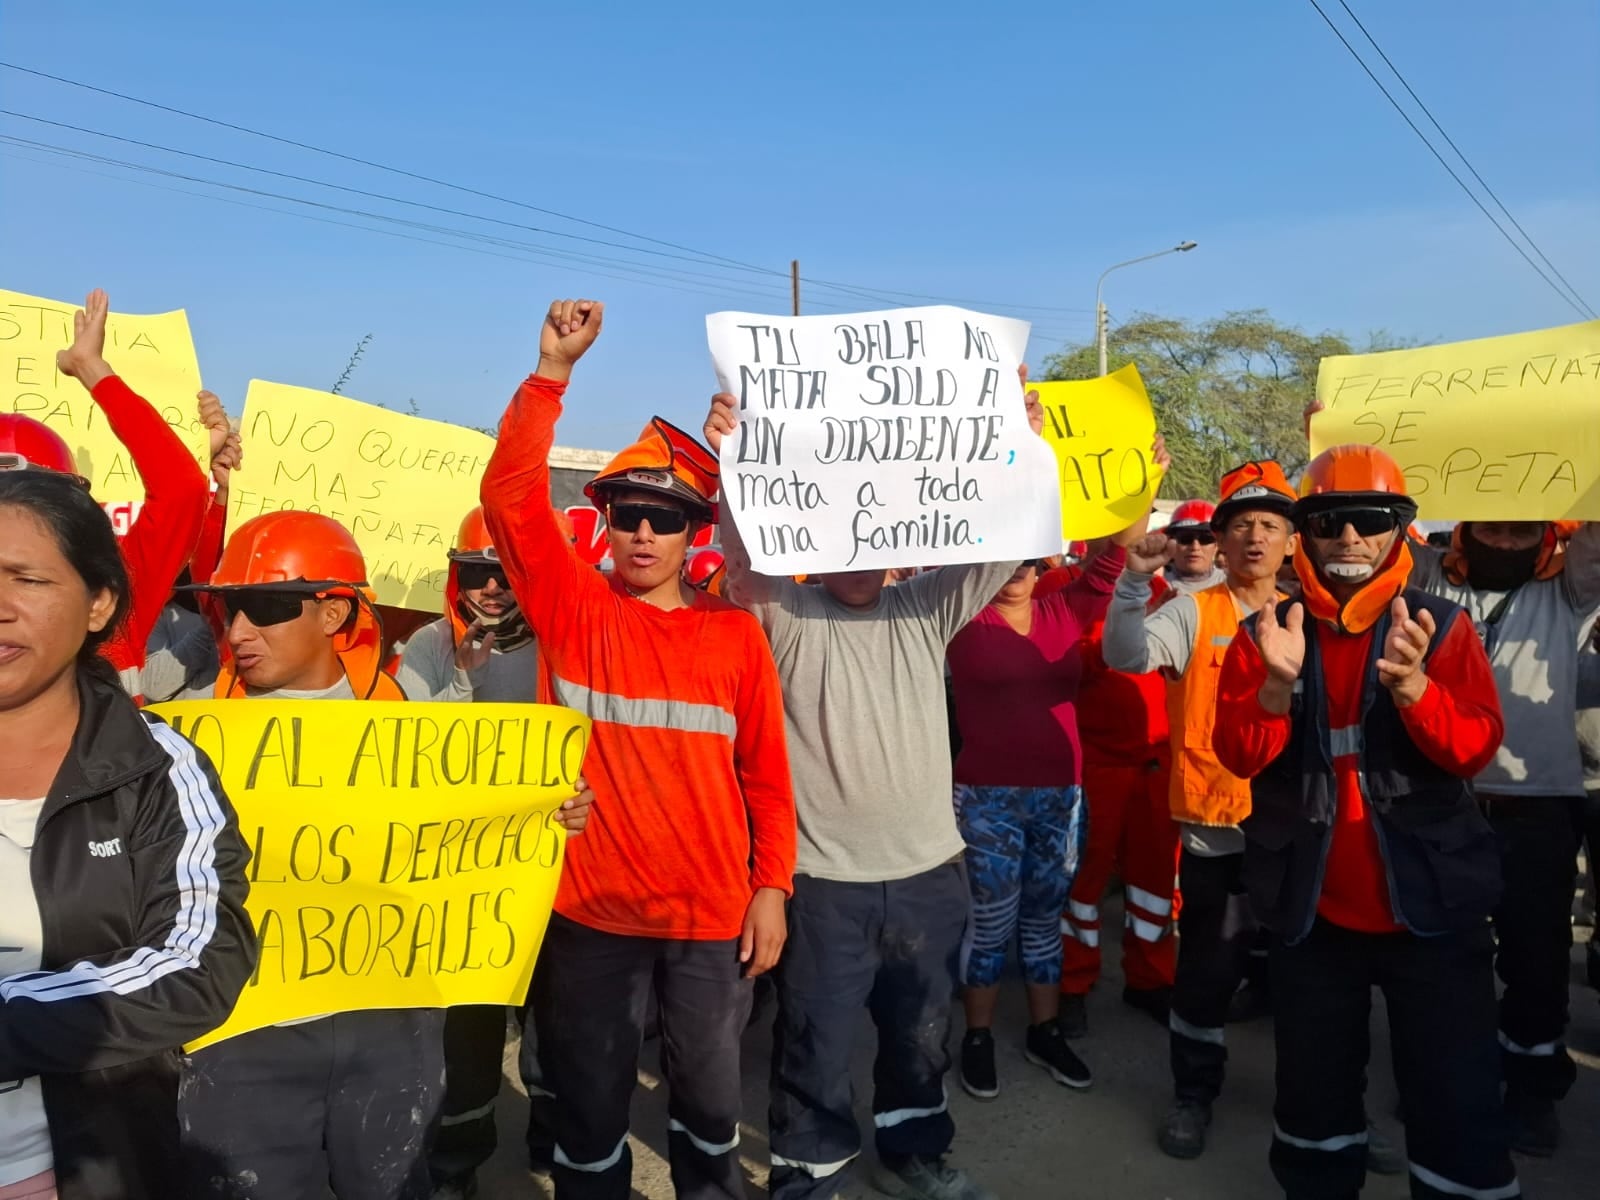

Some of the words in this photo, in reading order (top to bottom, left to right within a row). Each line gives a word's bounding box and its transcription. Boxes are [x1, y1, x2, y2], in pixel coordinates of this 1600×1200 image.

[736, 325, 801, 365] TU
[834, 320, 926, 364] BALA
[964, 321, 1000, 363] NO
[739, 365, 827, 410] MATA
[859, 365, 958, 406] SOLO
[977, 368, 1000, 408] A
[251, 410, 335, 453] NO
[736, 416, 786, 466] UN
[814, 415, 1016, 465] DIRIGENTE,
[1043, 404, 1087, 440] AL
[1353, 411, 1426, 445] SE
[274, 460, 387, 503] MAS
[737, 470, 830, 511] mata
[856, 481, 887, 508] a
[914, 467, 984, 502] toda
[1063, 447, 1147, 501] ATO
[758, 524, 820, 556] una
[845, 509, 984, 566] familia.
[244, 717, 323, 790] AL
[346, 716, 587, 789] ATROPELLO
[250, 824, 355, 884] LOS
[378, 807, 561, 884] DERECHOS
